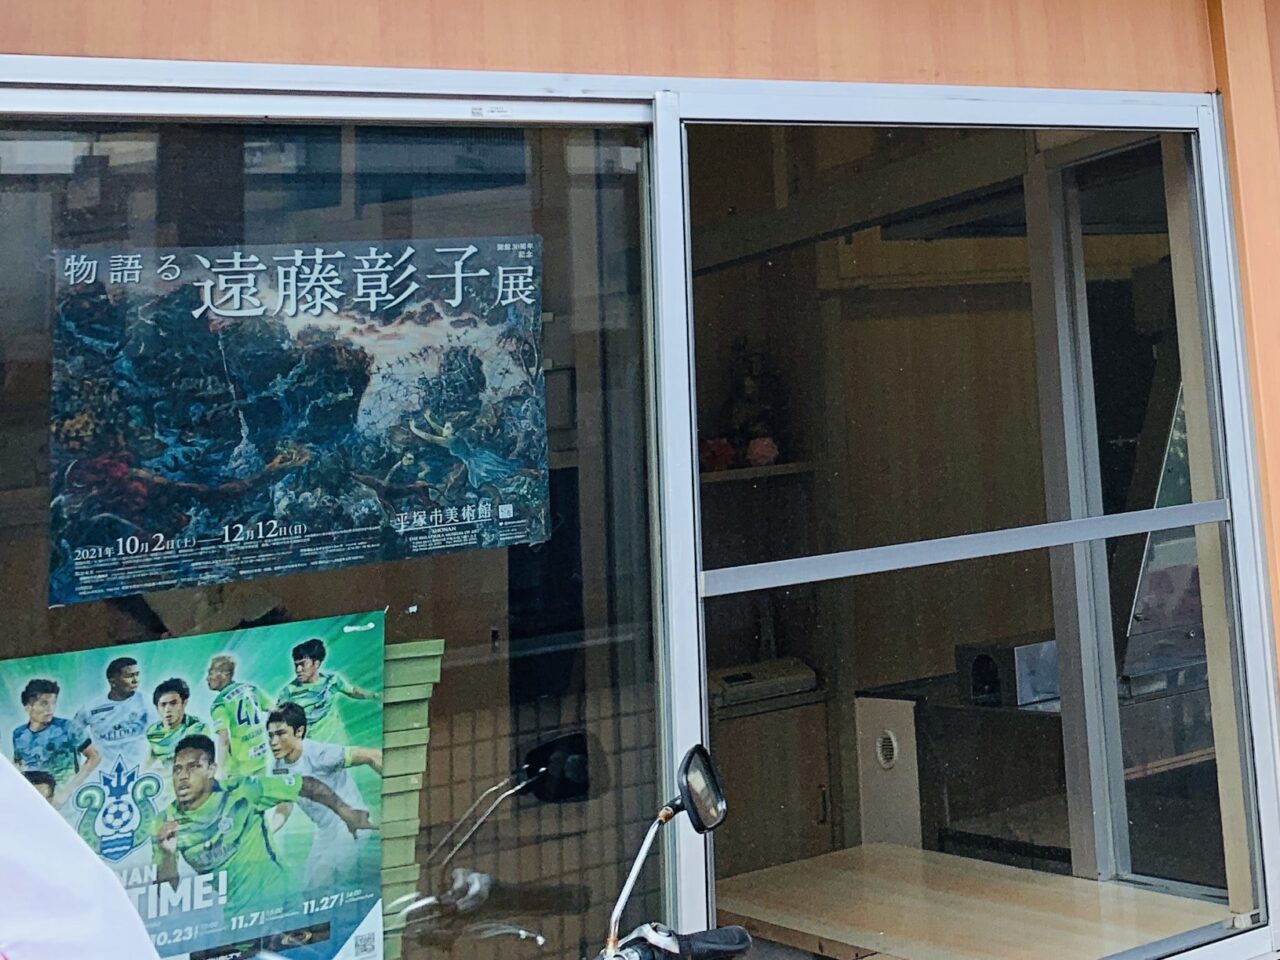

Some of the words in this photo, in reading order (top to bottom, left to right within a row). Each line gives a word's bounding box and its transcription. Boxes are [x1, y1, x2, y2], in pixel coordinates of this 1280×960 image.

[64, 253, 181, 285] 物語る
[396, 502, 491, 532] 平塚市美術館
